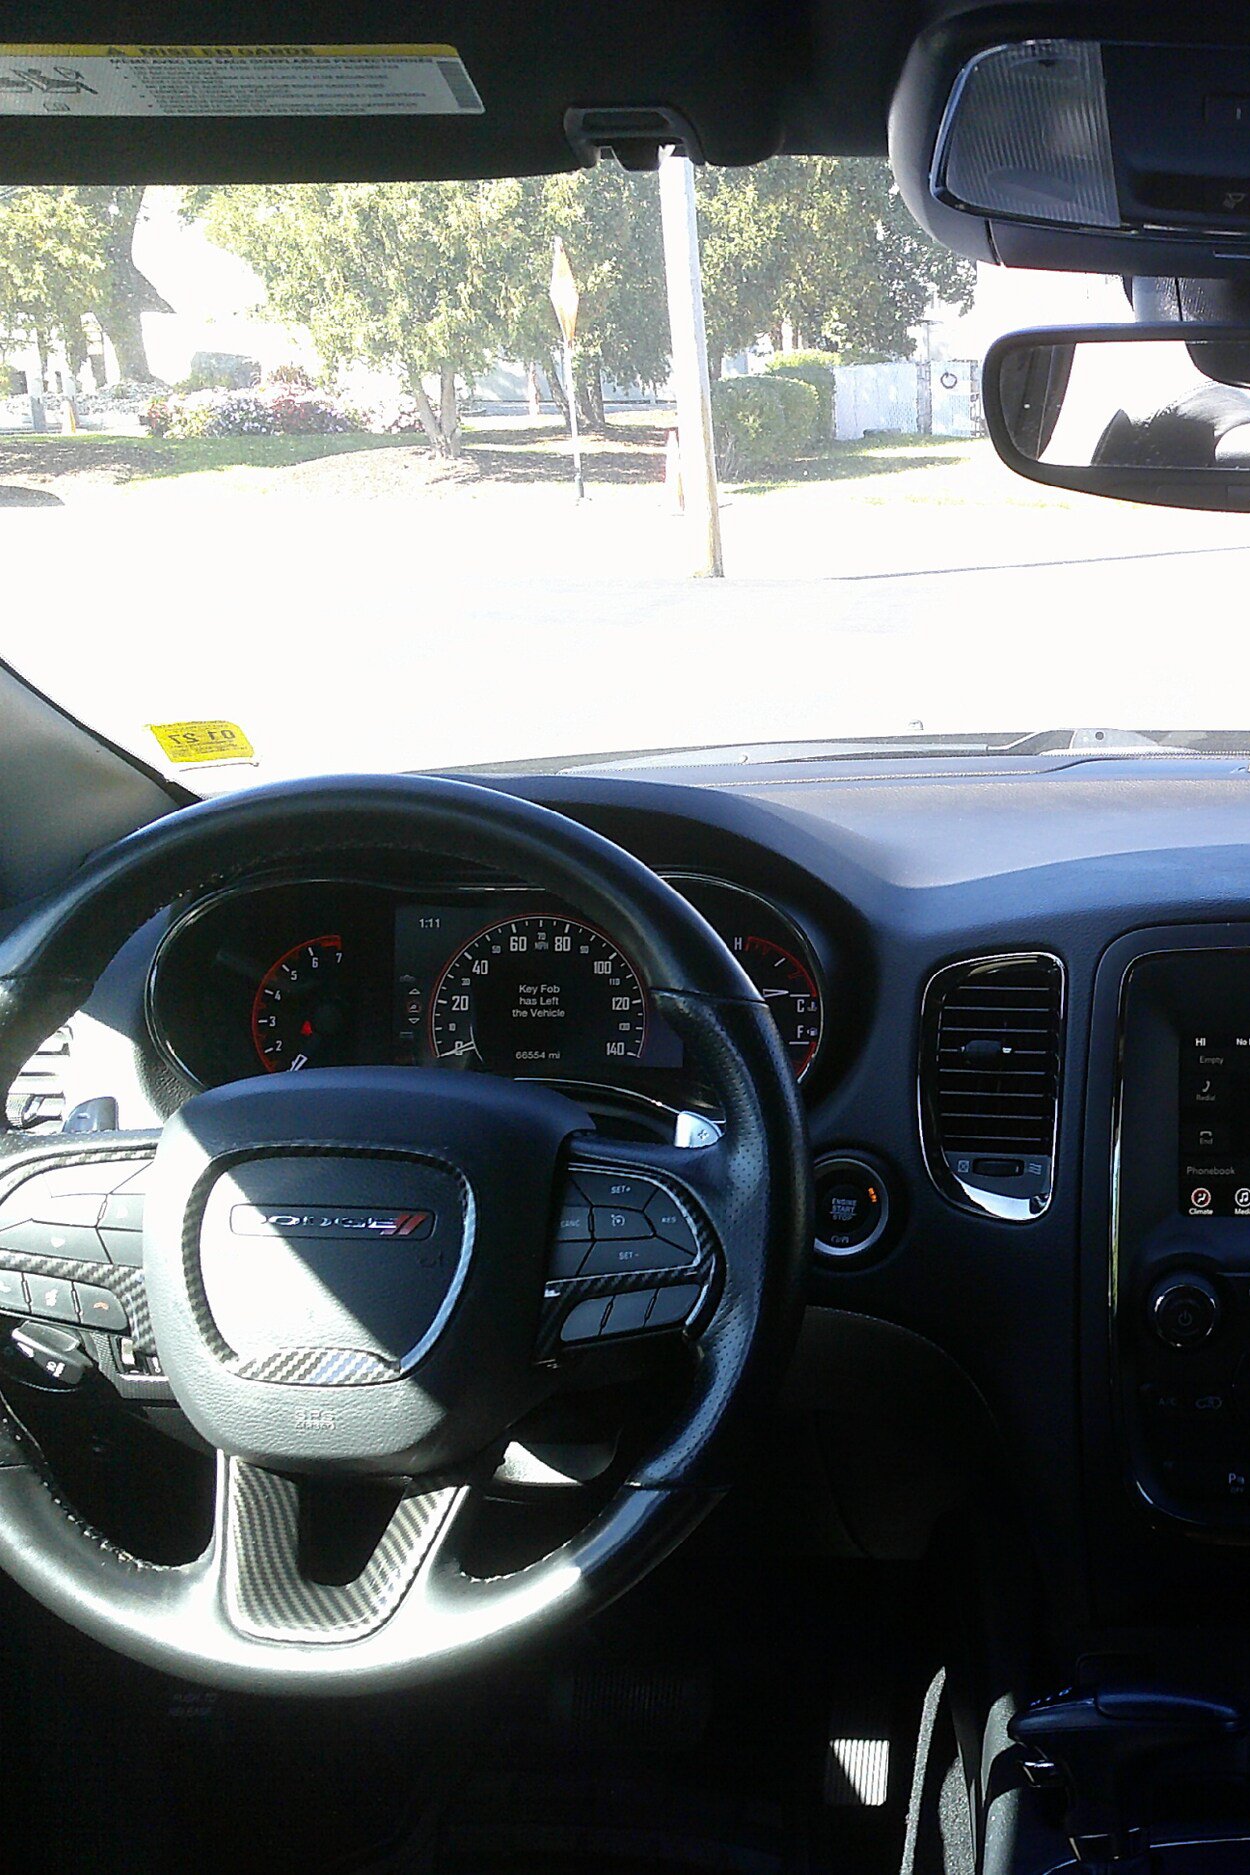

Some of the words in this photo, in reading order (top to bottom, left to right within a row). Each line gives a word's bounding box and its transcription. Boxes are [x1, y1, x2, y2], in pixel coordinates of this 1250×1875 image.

[138, 47, 199, 57] MISE
[202, 47, 232, 57] EN
[237, 46, 312, 57] GARDE
[419, 918, 440, 928] 1:11
[510, 936, 527, 951] 60
[555, 936, 571, 951] 80
[734, 937, 742, 950] H
[311, 957, 319, 968] 6
[336, 952, 342, 963] 7
[472, 960, 488, 975] 40
[594, 961, 612, 975] 100
[290, 971, 297, 981] 5
[273, 990, 281, 1000] 4
[519, 985, 537, 995] Key
[540, 984, 560, 993] Fob
[452, 996, 469, 1011] 20
[519, 996, 537, 1006] has
[540, 996, 559, 1006] Left
[612, 997, 630, 1011] 120
[797, 999, 805, 1013] C
[512, 1009, 529, 1018] the
[530, 1009, 565, 1018] Vehicle
[269, 1016, 276, 1027] 3
[797, 1025, 804, 1039] F
[275, 1040, 283, 1051] 2
[1194, 1037, 1207, 1047] HI
[1235, 1037, 1247, 1046] No
[606, 1042, 625, 1056] 140
[515, 1051, 546, 1060] 66554
[548, 1051, 561, 1060] mi
[1199, 1055, 1224, 1066] Empty
[1186, 1165, 1235, 1176] Phonebook
[1188, 1208, 1214, 1216] Climate
